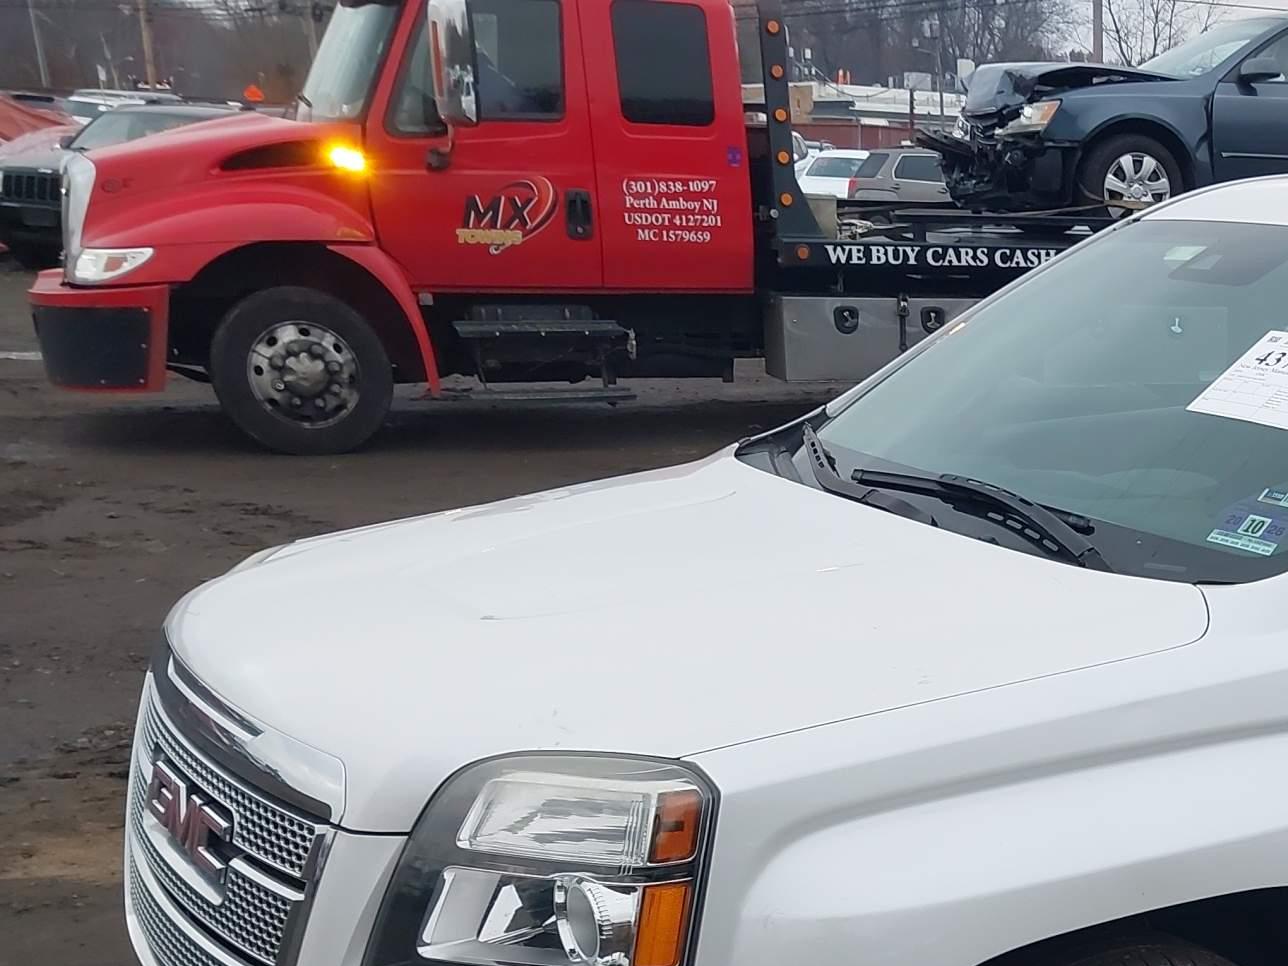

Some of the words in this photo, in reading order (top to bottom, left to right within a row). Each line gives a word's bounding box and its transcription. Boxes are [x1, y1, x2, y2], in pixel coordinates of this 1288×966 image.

[623, 178, 717, 196] (301)838-1097
[464, 194, 539, 230] MX
[625, 195, 658, 209] Perth
[660, 197, 701, 214] Amboy
[703, 198, 718, 214] NJ
[624, 212, 671, 226] USDOT
[672, 214, 721, 227] 4127201
[637, 229, 659, 241] MC
[662, 230, 711, 243] 1579659
[824, 245, 866, 265] WE
[869, 246, 920, 265] BUY
[926, 248, 988, 267] CARS
[994, 249, 1057, 268] CASH
[1244, 518, 1266, 535] 10
